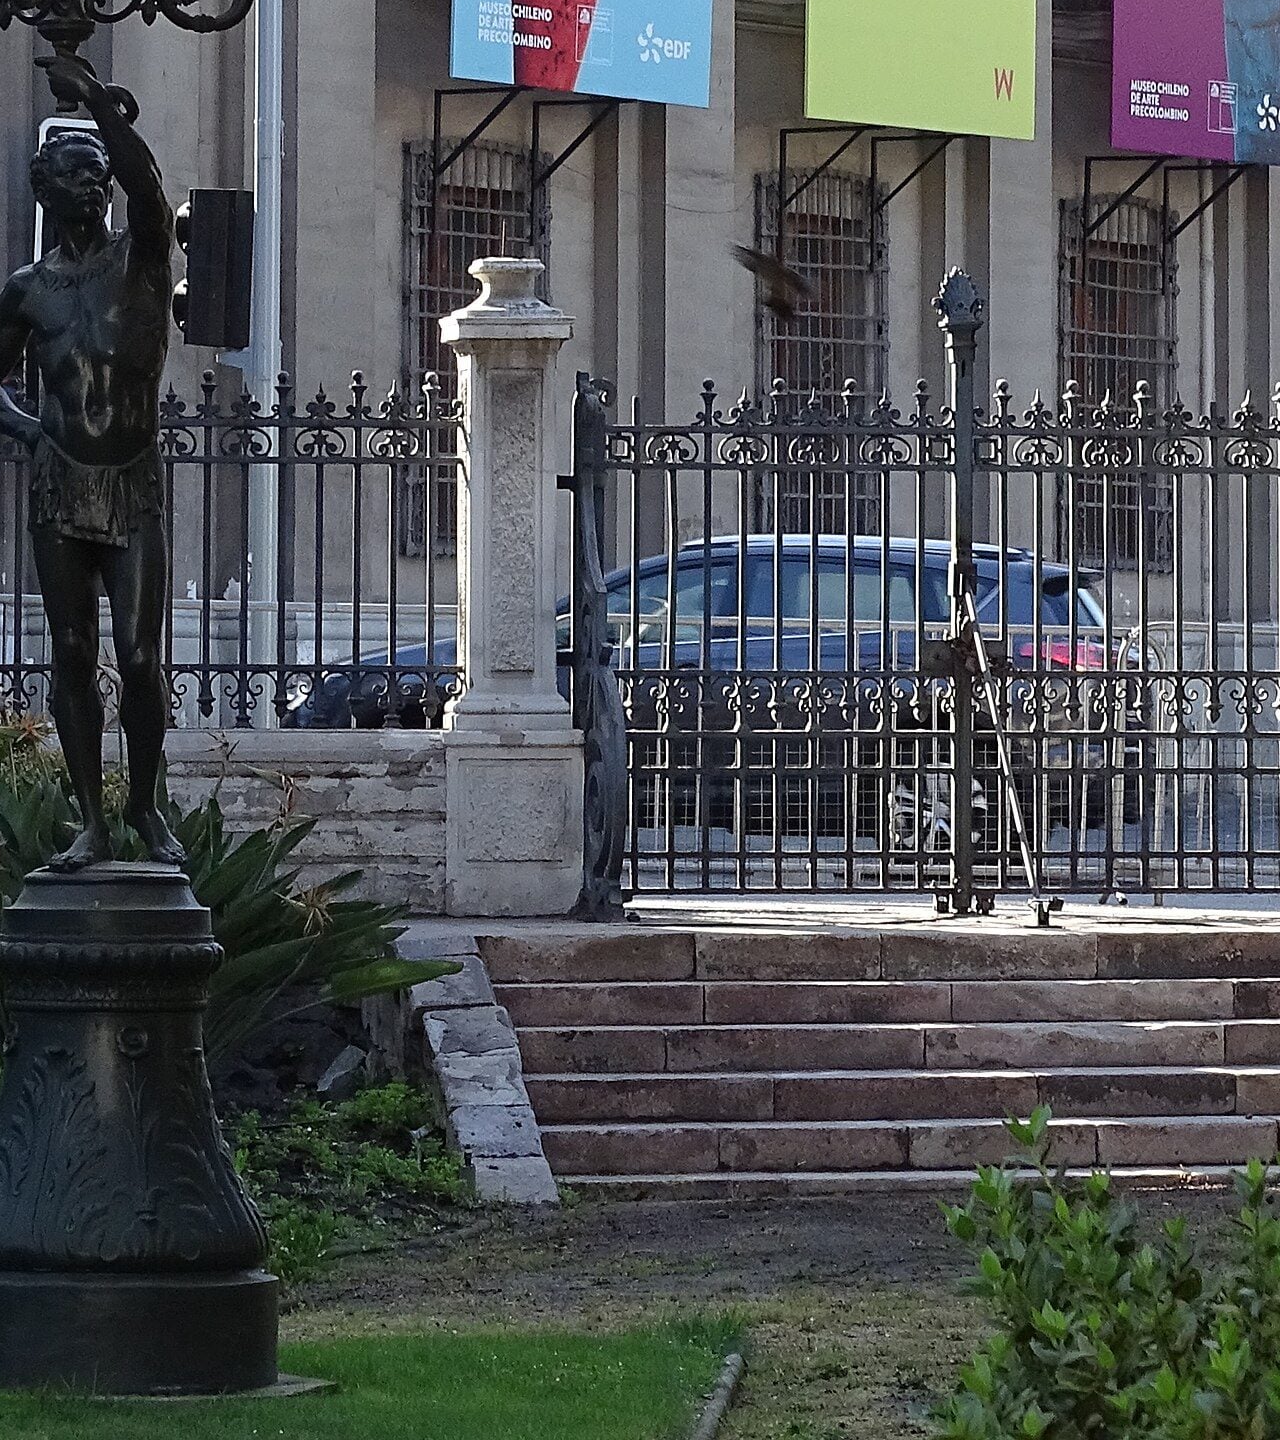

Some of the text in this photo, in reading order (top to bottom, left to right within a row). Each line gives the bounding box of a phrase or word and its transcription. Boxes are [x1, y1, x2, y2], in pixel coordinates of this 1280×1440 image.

[478, 1, 553, 22] MUSEO CHILENO
[478, 14, 515, 31] DE ARTE
[478, 28, 552, 50] PRECOLOMBINO
[994, 67, 1015, 102] W
[1130, 79, 1190, 97] MUSEO CHILENO
[1130, 91, 1160, 106] DE ARTE
[1130, 103, 1189, 122] PRECOLOMBINO
